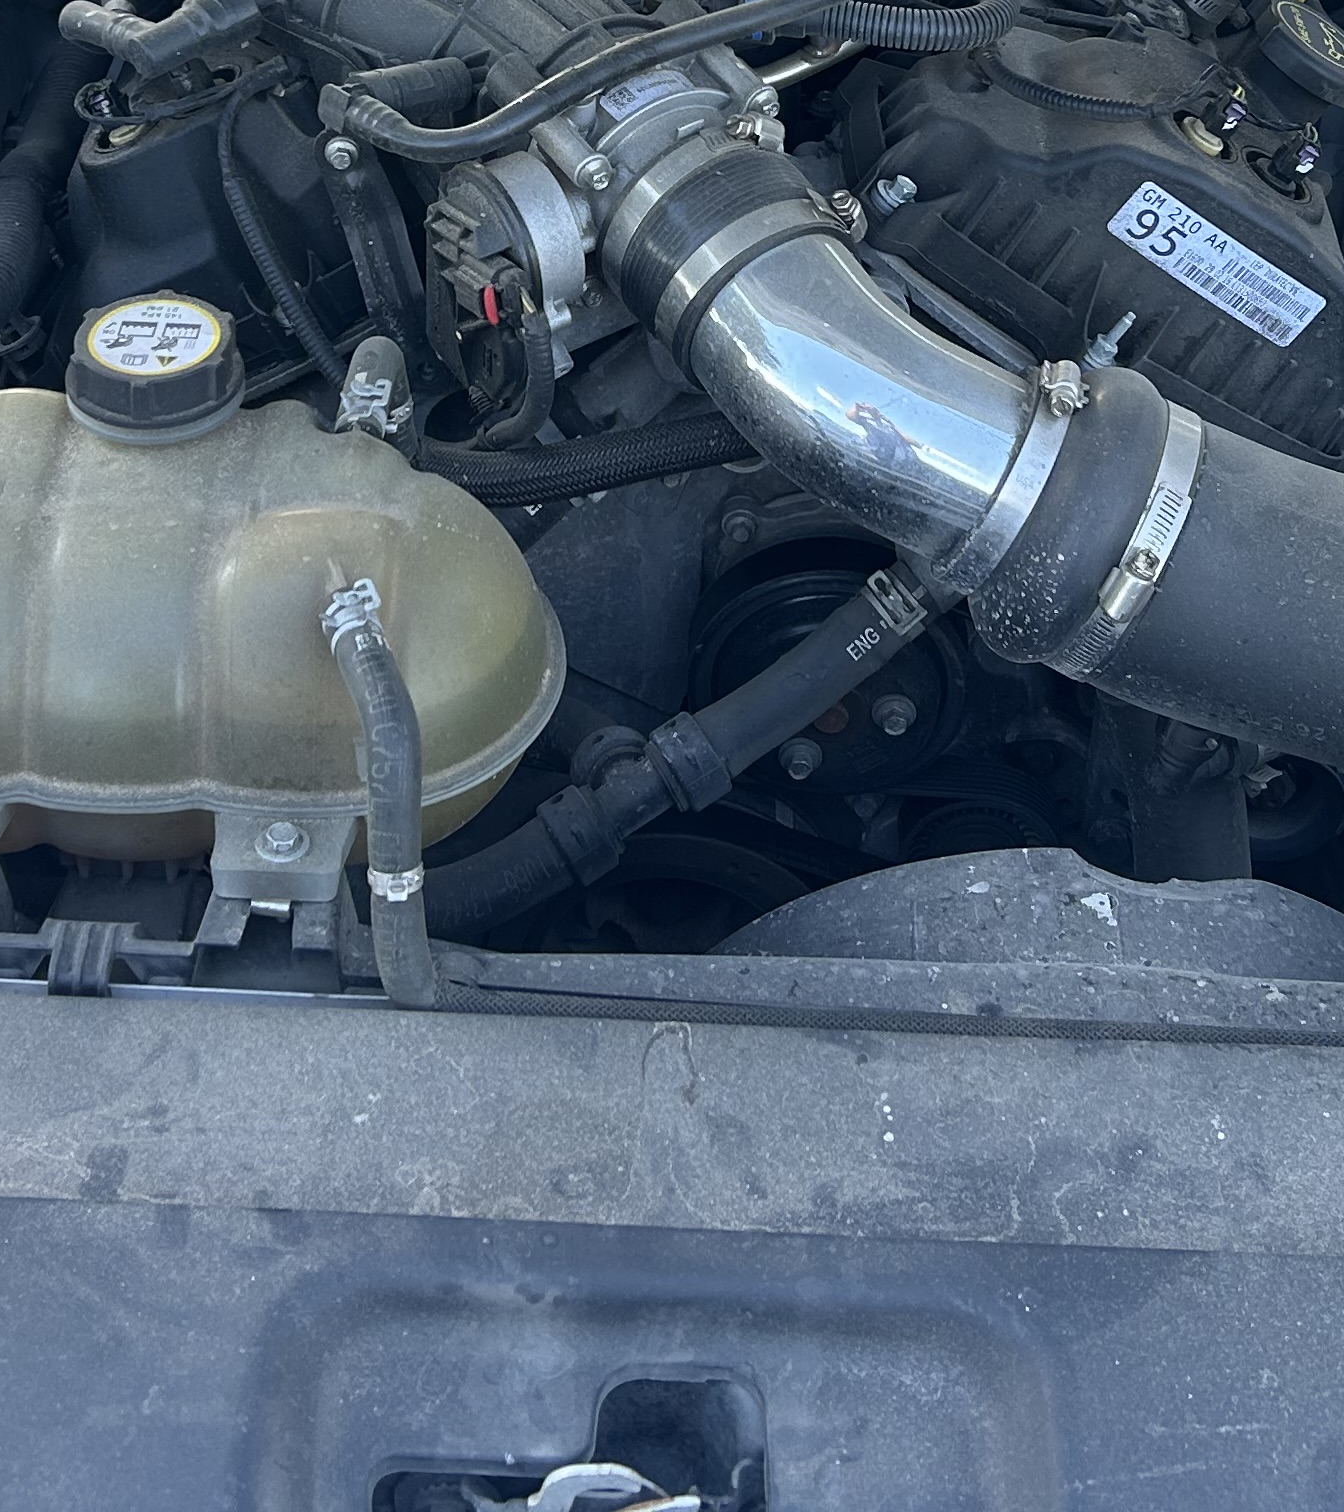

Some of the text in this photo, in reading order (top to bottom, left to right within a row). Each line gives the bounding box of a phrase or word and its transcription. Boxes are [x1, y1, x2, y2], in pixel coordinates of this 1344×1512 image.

[1125, 208, 1188, 257] 95
[1142, 188, 1228, 254] GM 210 AA
[845, 625, 882, 663] ENG
